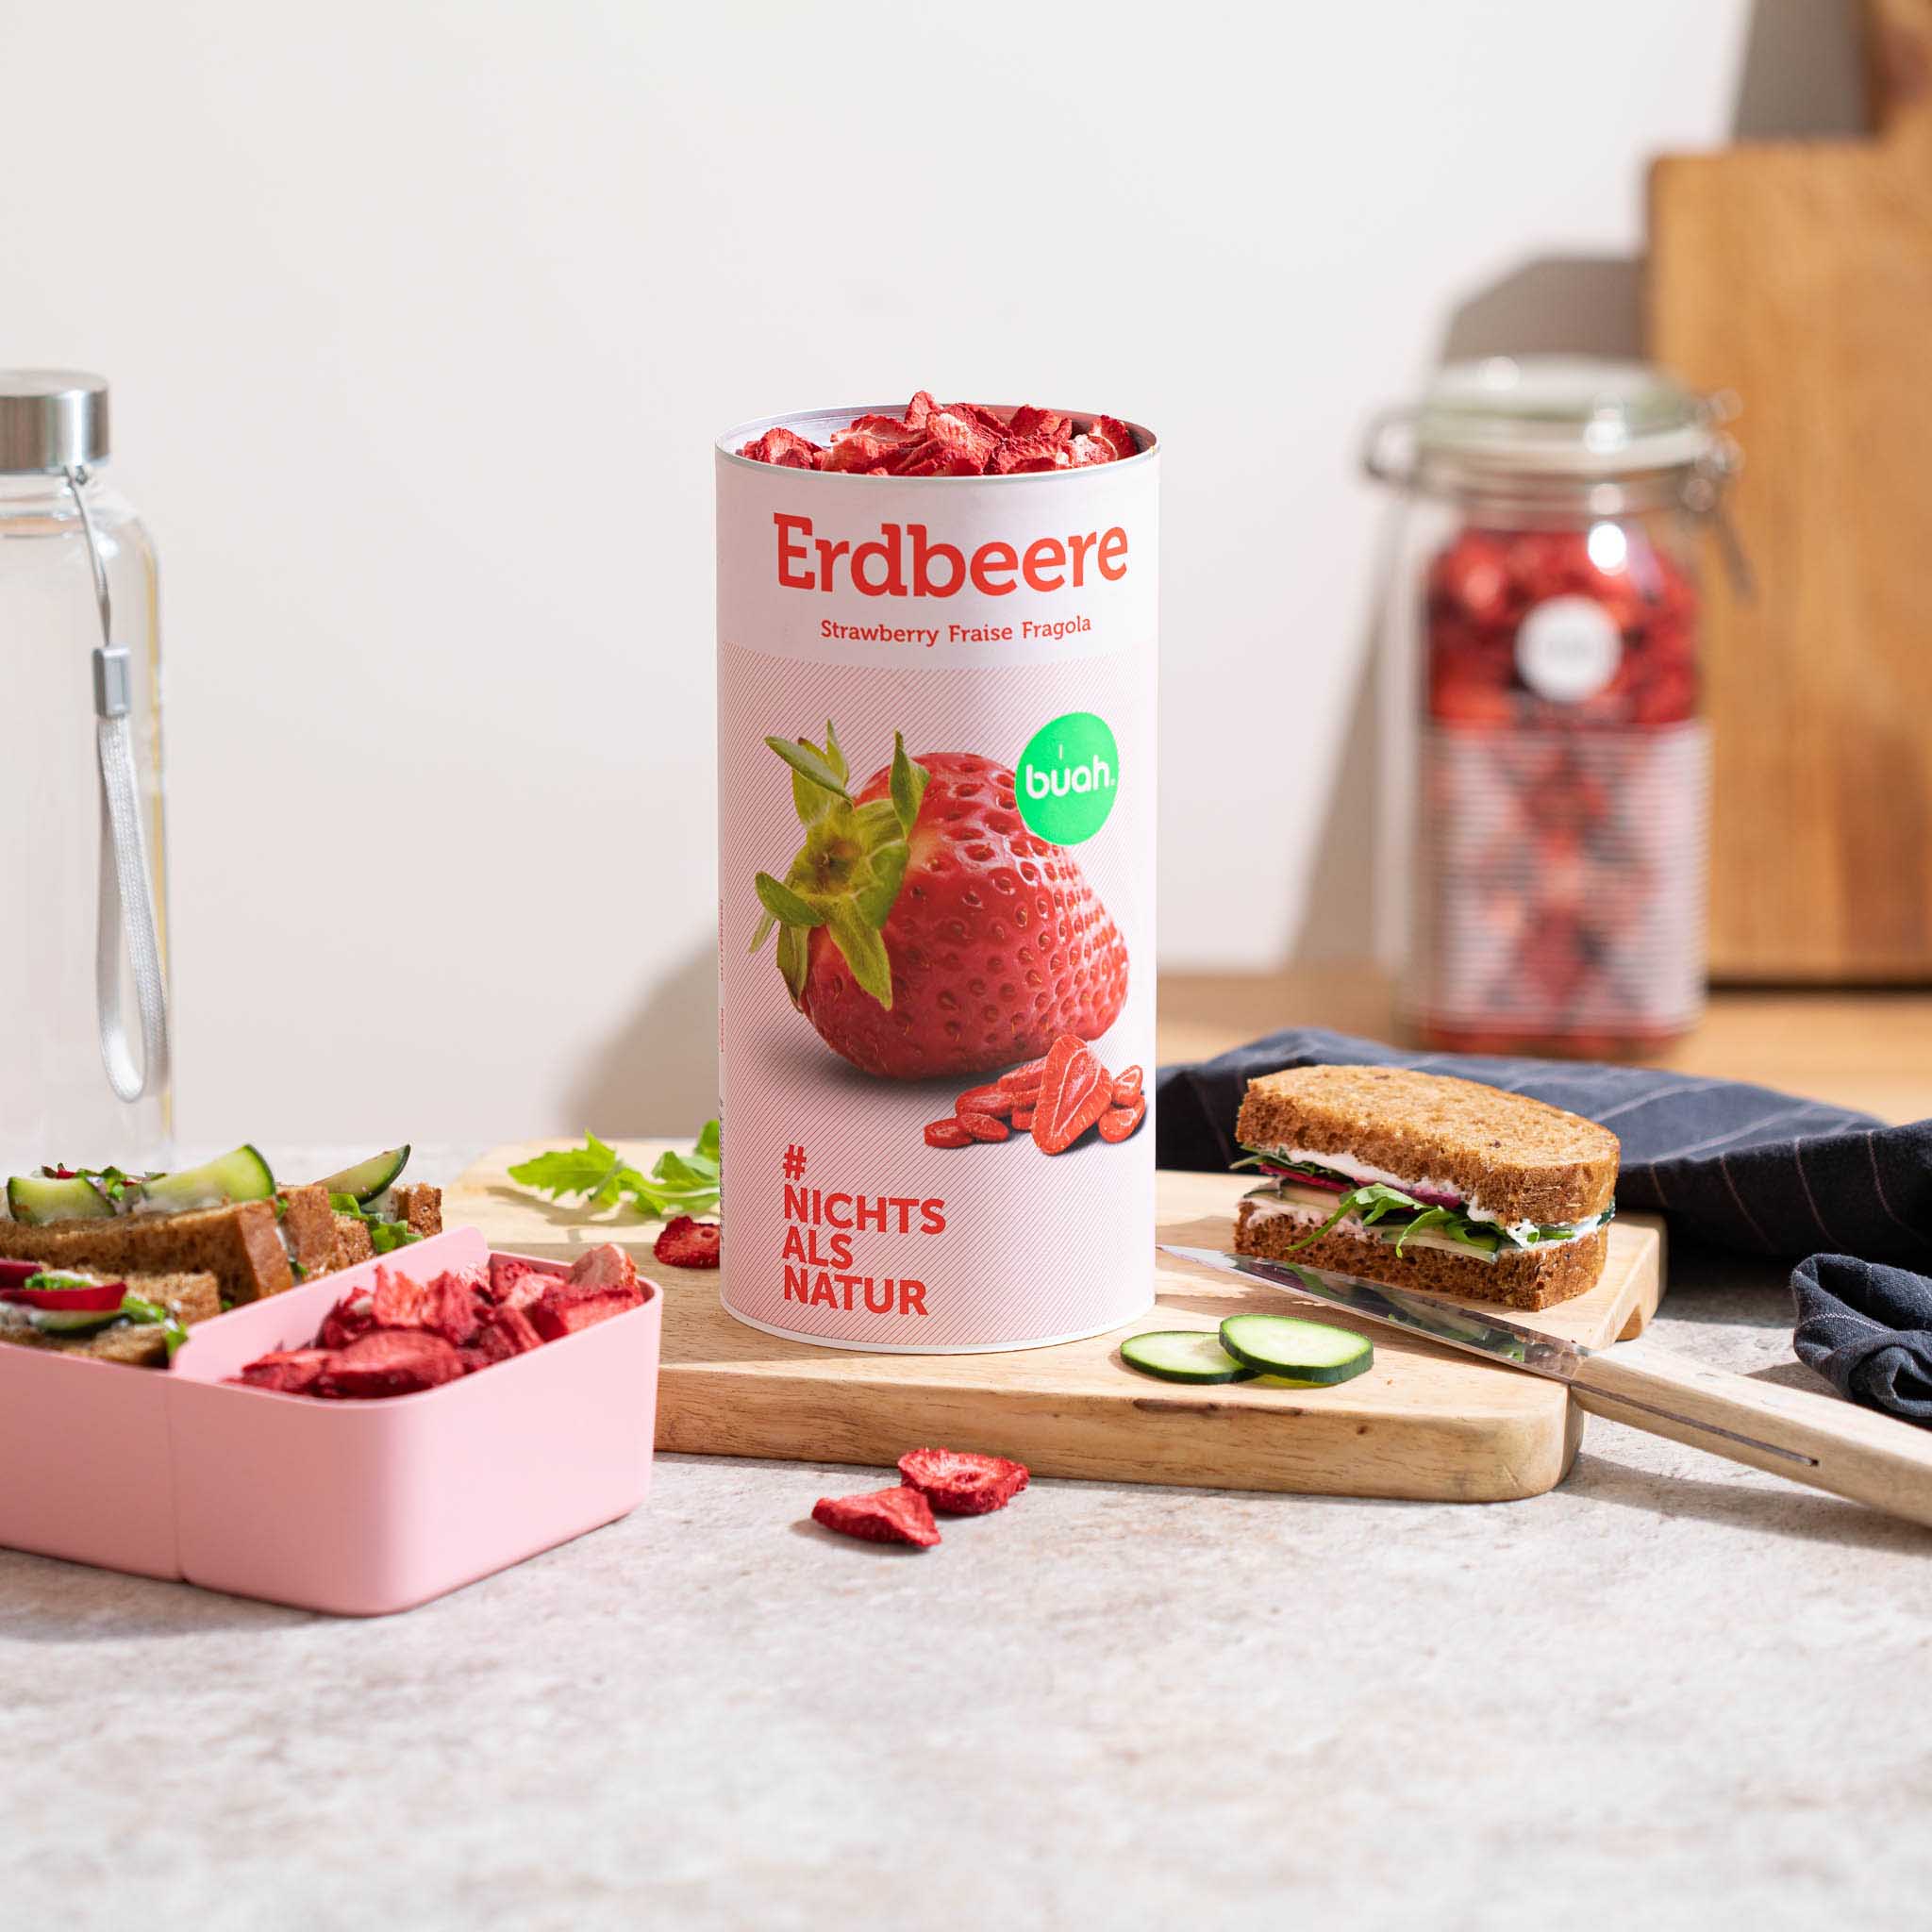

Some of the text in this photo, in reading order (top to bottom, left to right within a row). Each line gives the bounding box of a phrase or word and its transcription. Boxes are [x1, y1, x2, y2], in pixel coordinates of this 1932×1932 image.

[774, 512, 1128, 598] Erdbeere
[820, 615, 1092, 648] Strawberry Fraise Fragola
[783, 1184, 947, 1235] NICHTS
[781, 1225, 853, 1270] ALS
[783, 1264, 929, 1316] NATUR
